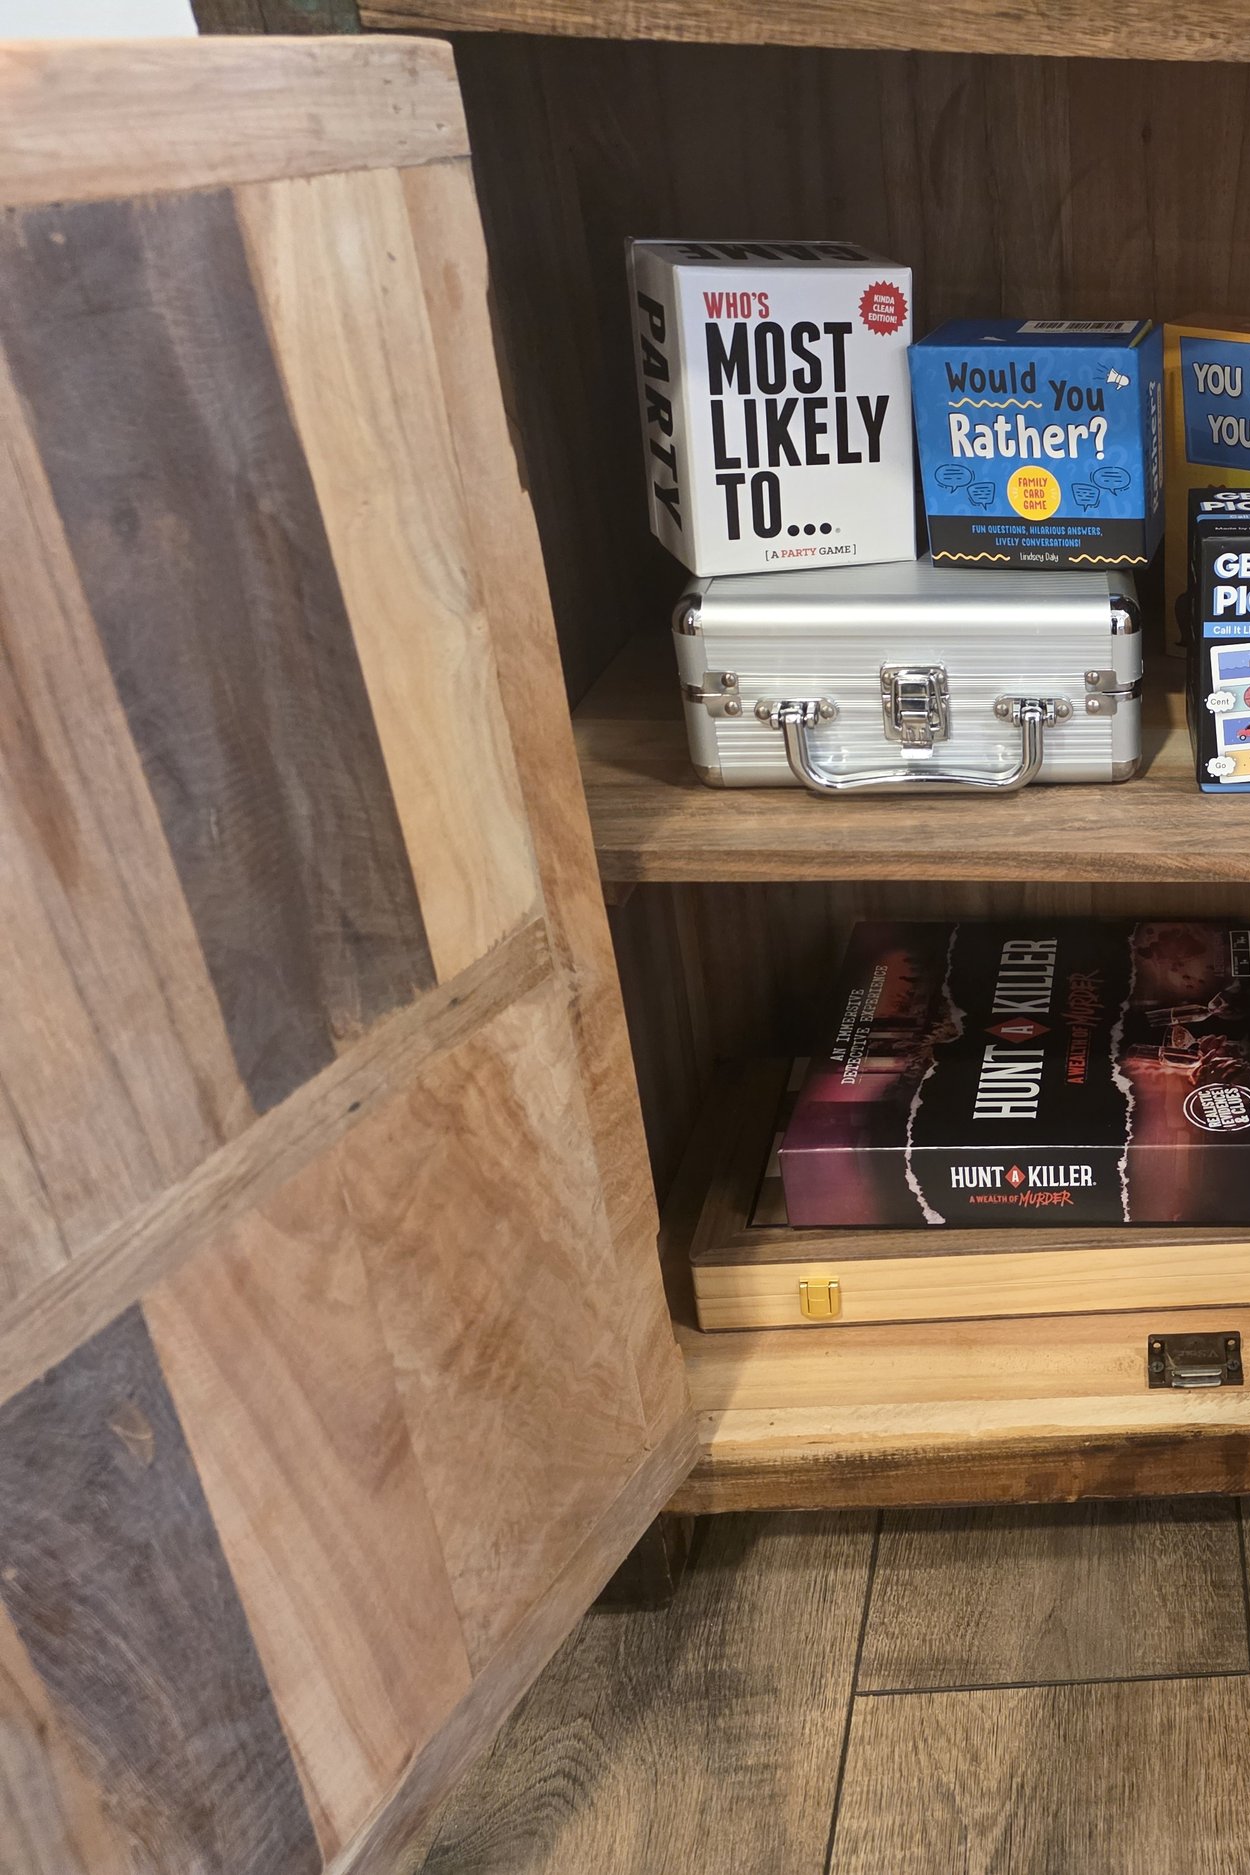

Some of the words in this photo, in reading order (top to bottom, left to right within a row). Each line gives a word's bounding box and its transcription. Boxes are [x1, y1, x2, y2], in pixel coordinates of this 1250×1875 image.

[703, 291, 769, 319] WHO'S
[872, 304, 895, 314] CLEAN
[873, 294, 896, 304] KINDA
[868, 313, 898, 324] EDITION!
[705, 321, 853, 395] MOST
[945, 361, 1036, 394] Would
[1048, 380, 1105, 412] You
[1193, 362, 1243, 397] YOU
[638, 291, 682, 533] PARTY
[710, 395, 890, 470] LIKELY
[949, 412, 1108, 460] Rather?
[1018, 477, 1048, 488] FAMILY
[1023, 489, 1045, 499] CARD
[1023, 500, 1047, 510] GAME
[972, 525, 986, 533] FUN
[988, 525, 1028, 536] QUESTIONS,
[1030, 526, 1066, 535] HILARIOUS
[1067, 526, 1103, 537] ANSWERS,
[995, 537, 1019, 546] LIVELY
[1021, 538, 1081, 547] CONVERSATIONS!
[781, 547, 817, 558] PARTY
[1020, 552, 1045, 562] Lindsey
[1045, 552, 1059, 563] Daly
[1213, 625, 1232, 635] Call
[1234, 626, 1241, 635] It
[1210, 698, 1230, 706] Cent
[1215, 762, 1227, 770] Go
[991, 938, 1058, 1013] KILLER
[1060, 968, 1104, 1027] MURDER
[836, 988, 865, 1042] IMMERSIVE
[841, 1026, 871, 1085] DETECTIVE
[860, 964, 889, 1022] EXPERIENCE
[1001, 1024, 1034, 1035] A
[1072, 1026, 1089, 1037] OF
[830, 1046, 844, 1061] AN
[1068, 1039, 1088, 1076] WEALTH
[972, 1044, 1045, 1119] HUNT
[1198, 1090, 1222, 1128] REALISTIC
[1211, 1089, 1236, 1126] EVIDENCE
[1224, 1087, 1247, 1114] CLUES
[950, 1166, 1004, 1188] HUNT
[1011, 1170, 1019, 1183] A
[1028, 1165, 1093, 1187] KILLER
[969, 1195, 976, 1203] A
[977, 1195, 1008, 1203] WEALTH
[1010, 1195, 1019, 1203] OF
[1018, 1190, 1074, 1208] MURDER
